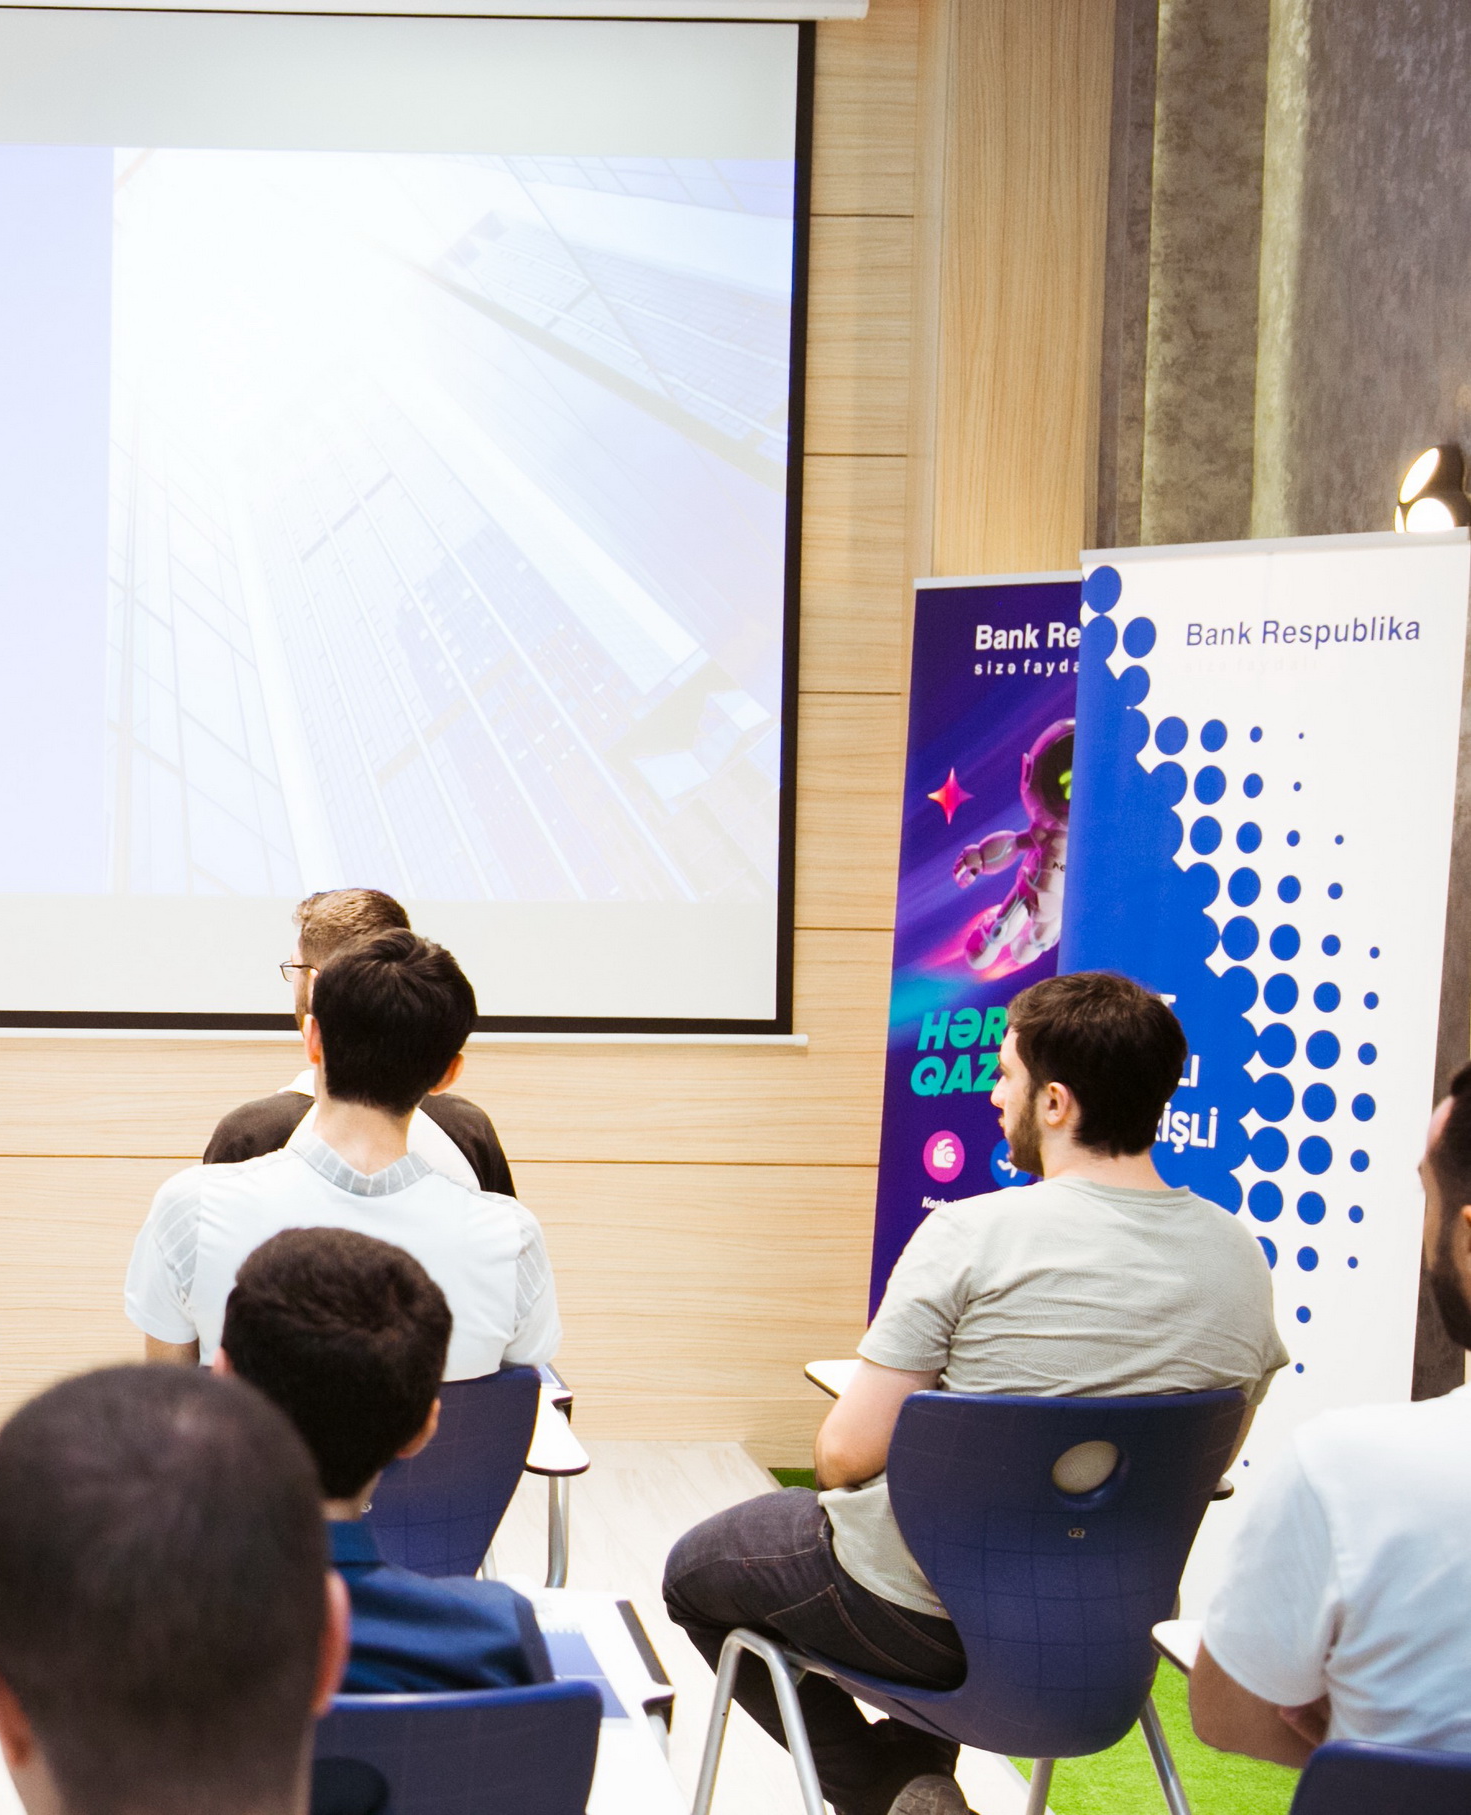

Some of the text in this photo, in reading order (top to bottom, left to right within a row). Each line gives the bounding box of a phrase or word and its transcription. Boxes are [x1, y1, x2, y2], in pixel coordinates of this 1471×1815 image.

[975, 623, 1040, 651] Bank
[1186, 616, 1421, 650] Bank Respublika
[917, 1006, 1008, 1051] HƏR
